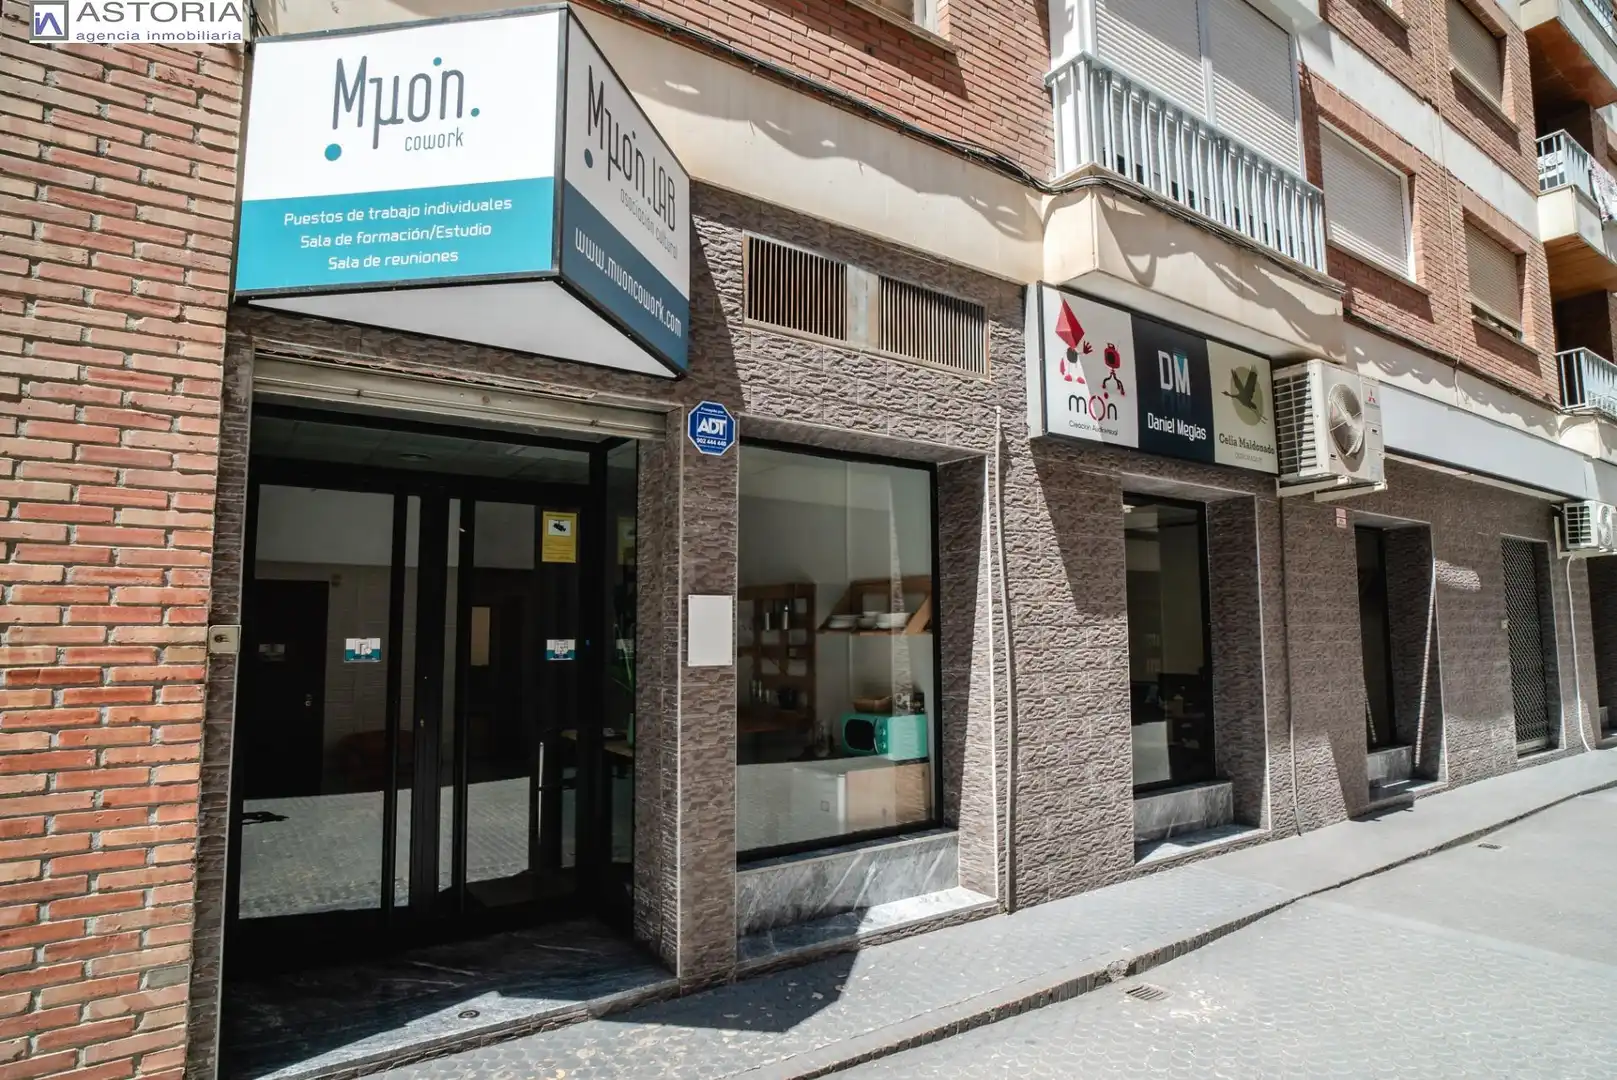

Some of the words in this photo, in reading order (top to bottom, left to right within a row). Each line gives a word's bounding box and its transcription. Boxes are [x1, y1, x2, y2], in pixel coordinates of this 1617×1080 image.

[404, 127, 464, 152] cowork
[284, 208, 343, 226] Puestos
[347, 208, 364, 222] de
[368, 204, 420, 221] trabajo
[424, 198, 512, 216] individuales
[301, 233, 331, 249] Sala
[335, 232, 351, 246] de
[356, 222, 492, 245] formación/Estudio
[328, 254, 360, 271] Sala
[363, 253, 381, 268] de
[384, 249, 459, 266] reuniones
[575, 227, 682, 339] www.muoncowork.com
[1158, 350, 1191, 396] DM
[697, 417, 727, 436] ADT
[1147, 412, 1175, 434] Daniel
[1218, 432, 1238, 447] Celia
[1238, 436, 1276, 455] Maldonado
